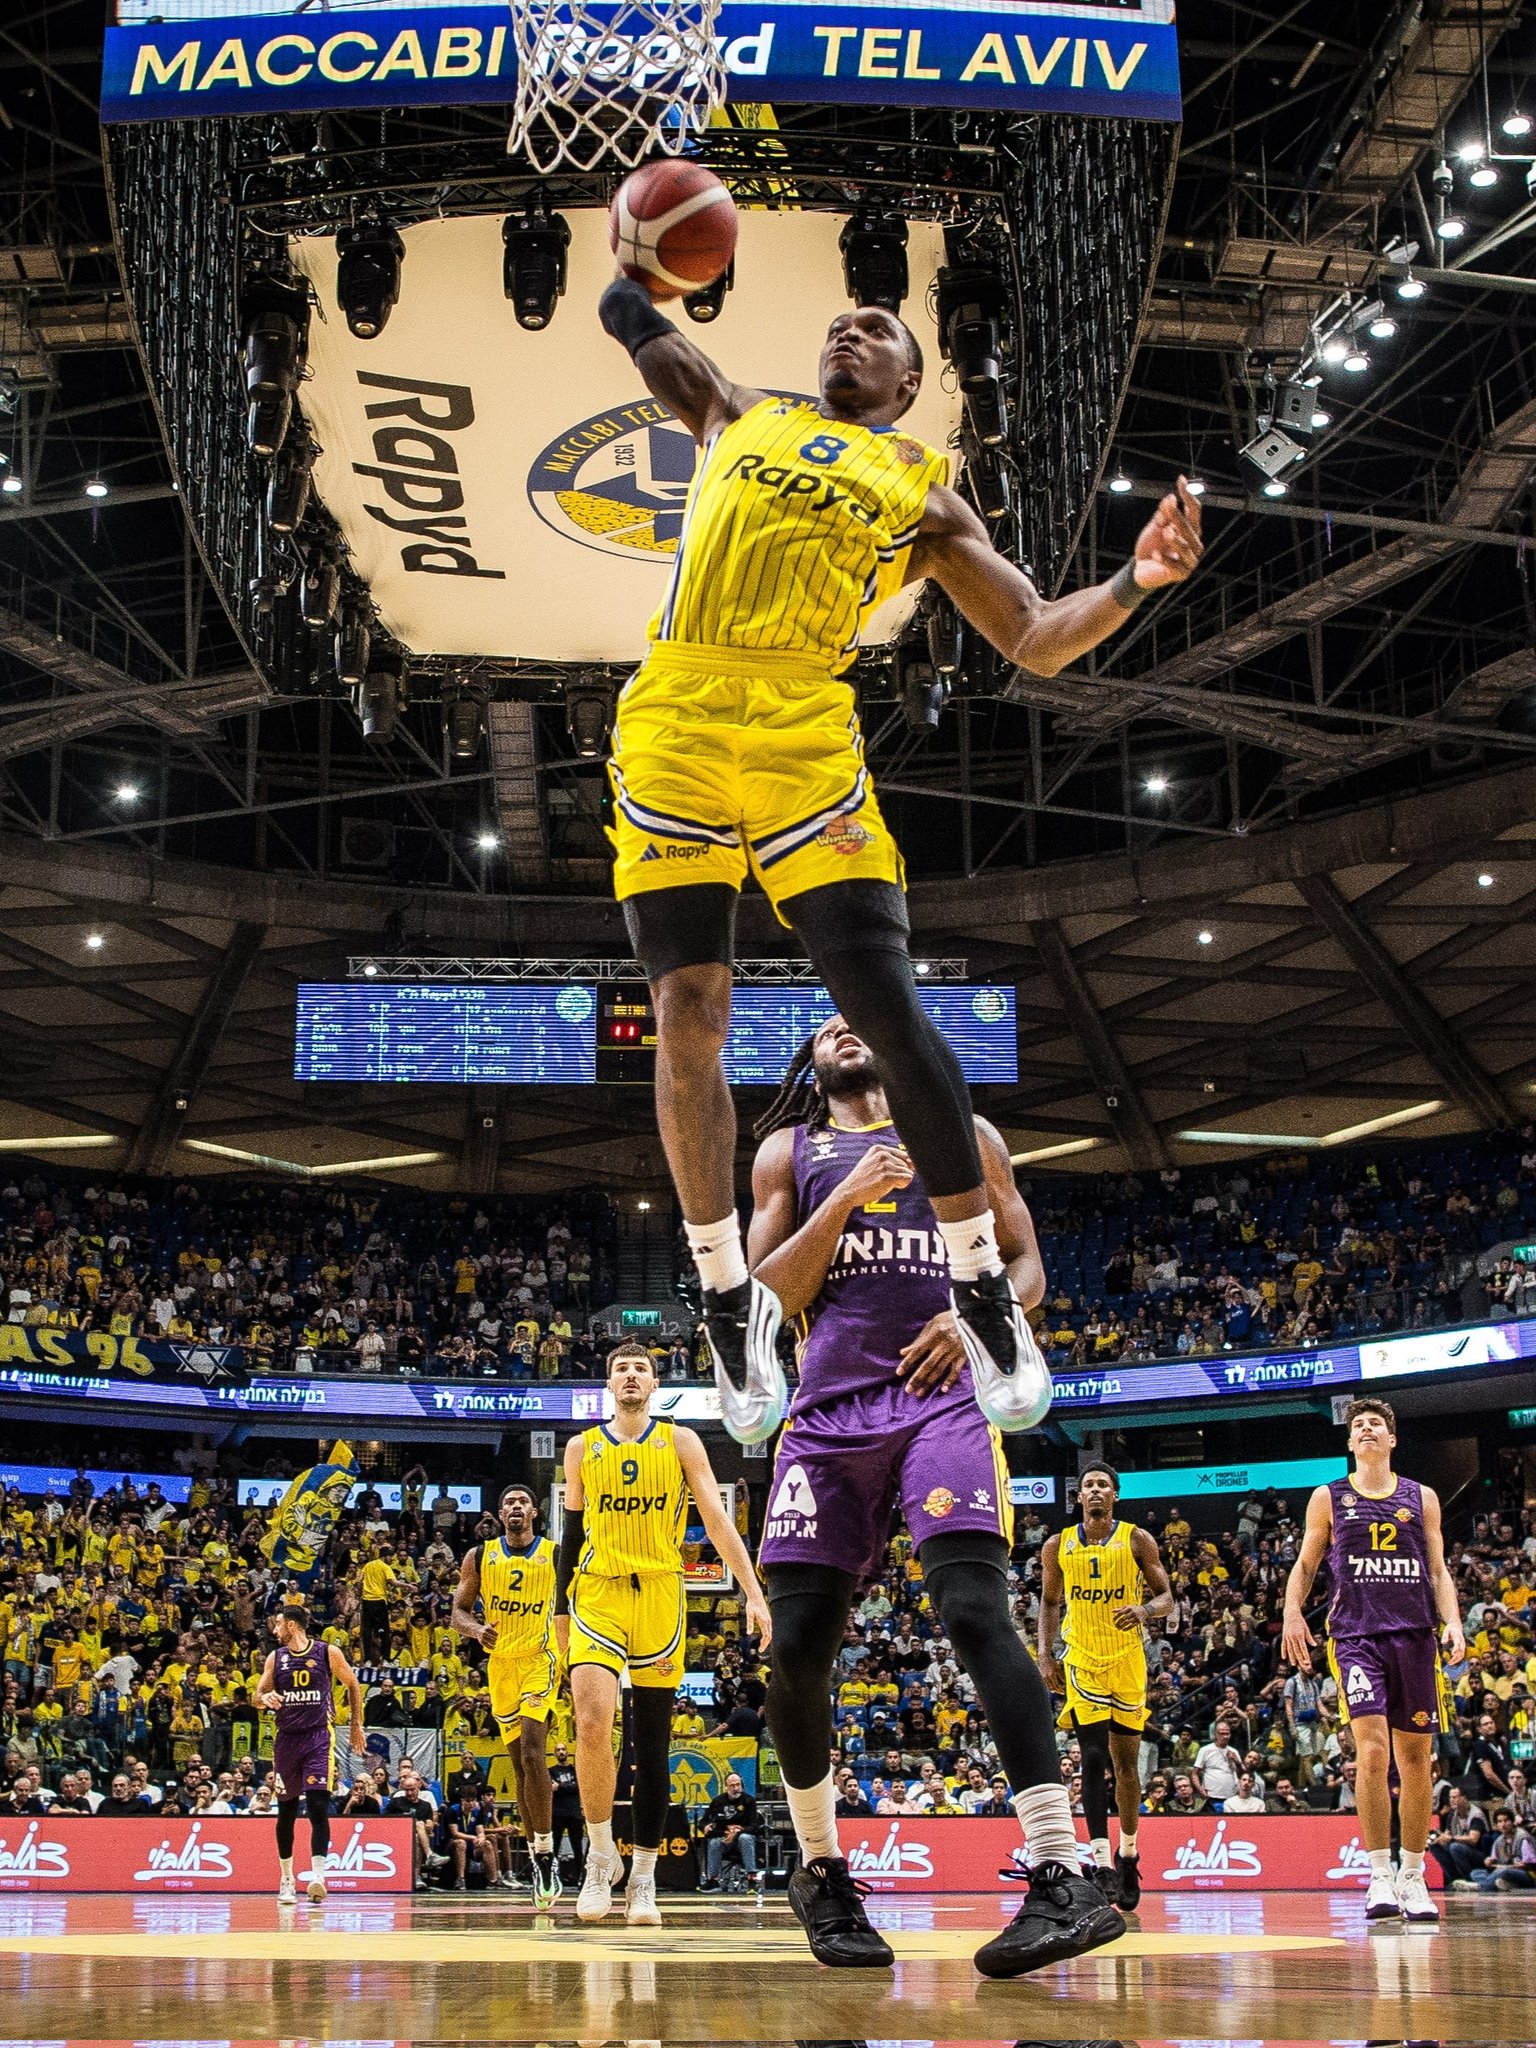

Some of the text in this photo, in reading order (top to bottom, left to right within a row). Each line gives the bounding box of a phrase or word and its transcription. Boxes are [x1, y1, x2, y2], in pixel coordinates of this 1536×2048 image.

[129, 22, 1148, 95] MACCABI Rapyd TEL AVIV
[544, 403, 671, 473] MACCABI TEL
[799, 434, 849, 465] 8
[614, 443, 636, 466] 1932
[352, 369, 506, 580] Rapyd
[722, 454, 881, 527] Rapyd
[666, 843, 709, 860] Rapyd
[828, 1264, 945, 1280] NETANEL GROUP
[86, 1331, 155, 1376] 96
[1224, 1357, 1335, 1384] במילה אחת: לד
[281, 1385, 326, 1404] במילה
[1078, 1376, 1122, 1397] במילה
[432, 1390, 543, 1411] במילה אחת: לד
[621, 1459, 639, 1486] 9
[1215, 1478, 1248, 1487] DRONES
[599, 1492, 668, 1515] Rapyd
[1368, 1522, 1397, 1551] 12
[1089, 1556, 1101, 1579] 1
[1348, 1554, 1420, 1577] נתנאל
[508, 1569, 523, 1591] 2
[490, 1595, 544, 1616] Rapyd
[1070, 1585, 1125, 1604] Rapyd
[292, 1670, 310, 1688] 10
[283, 1690, 321, 1702] נתנאל
